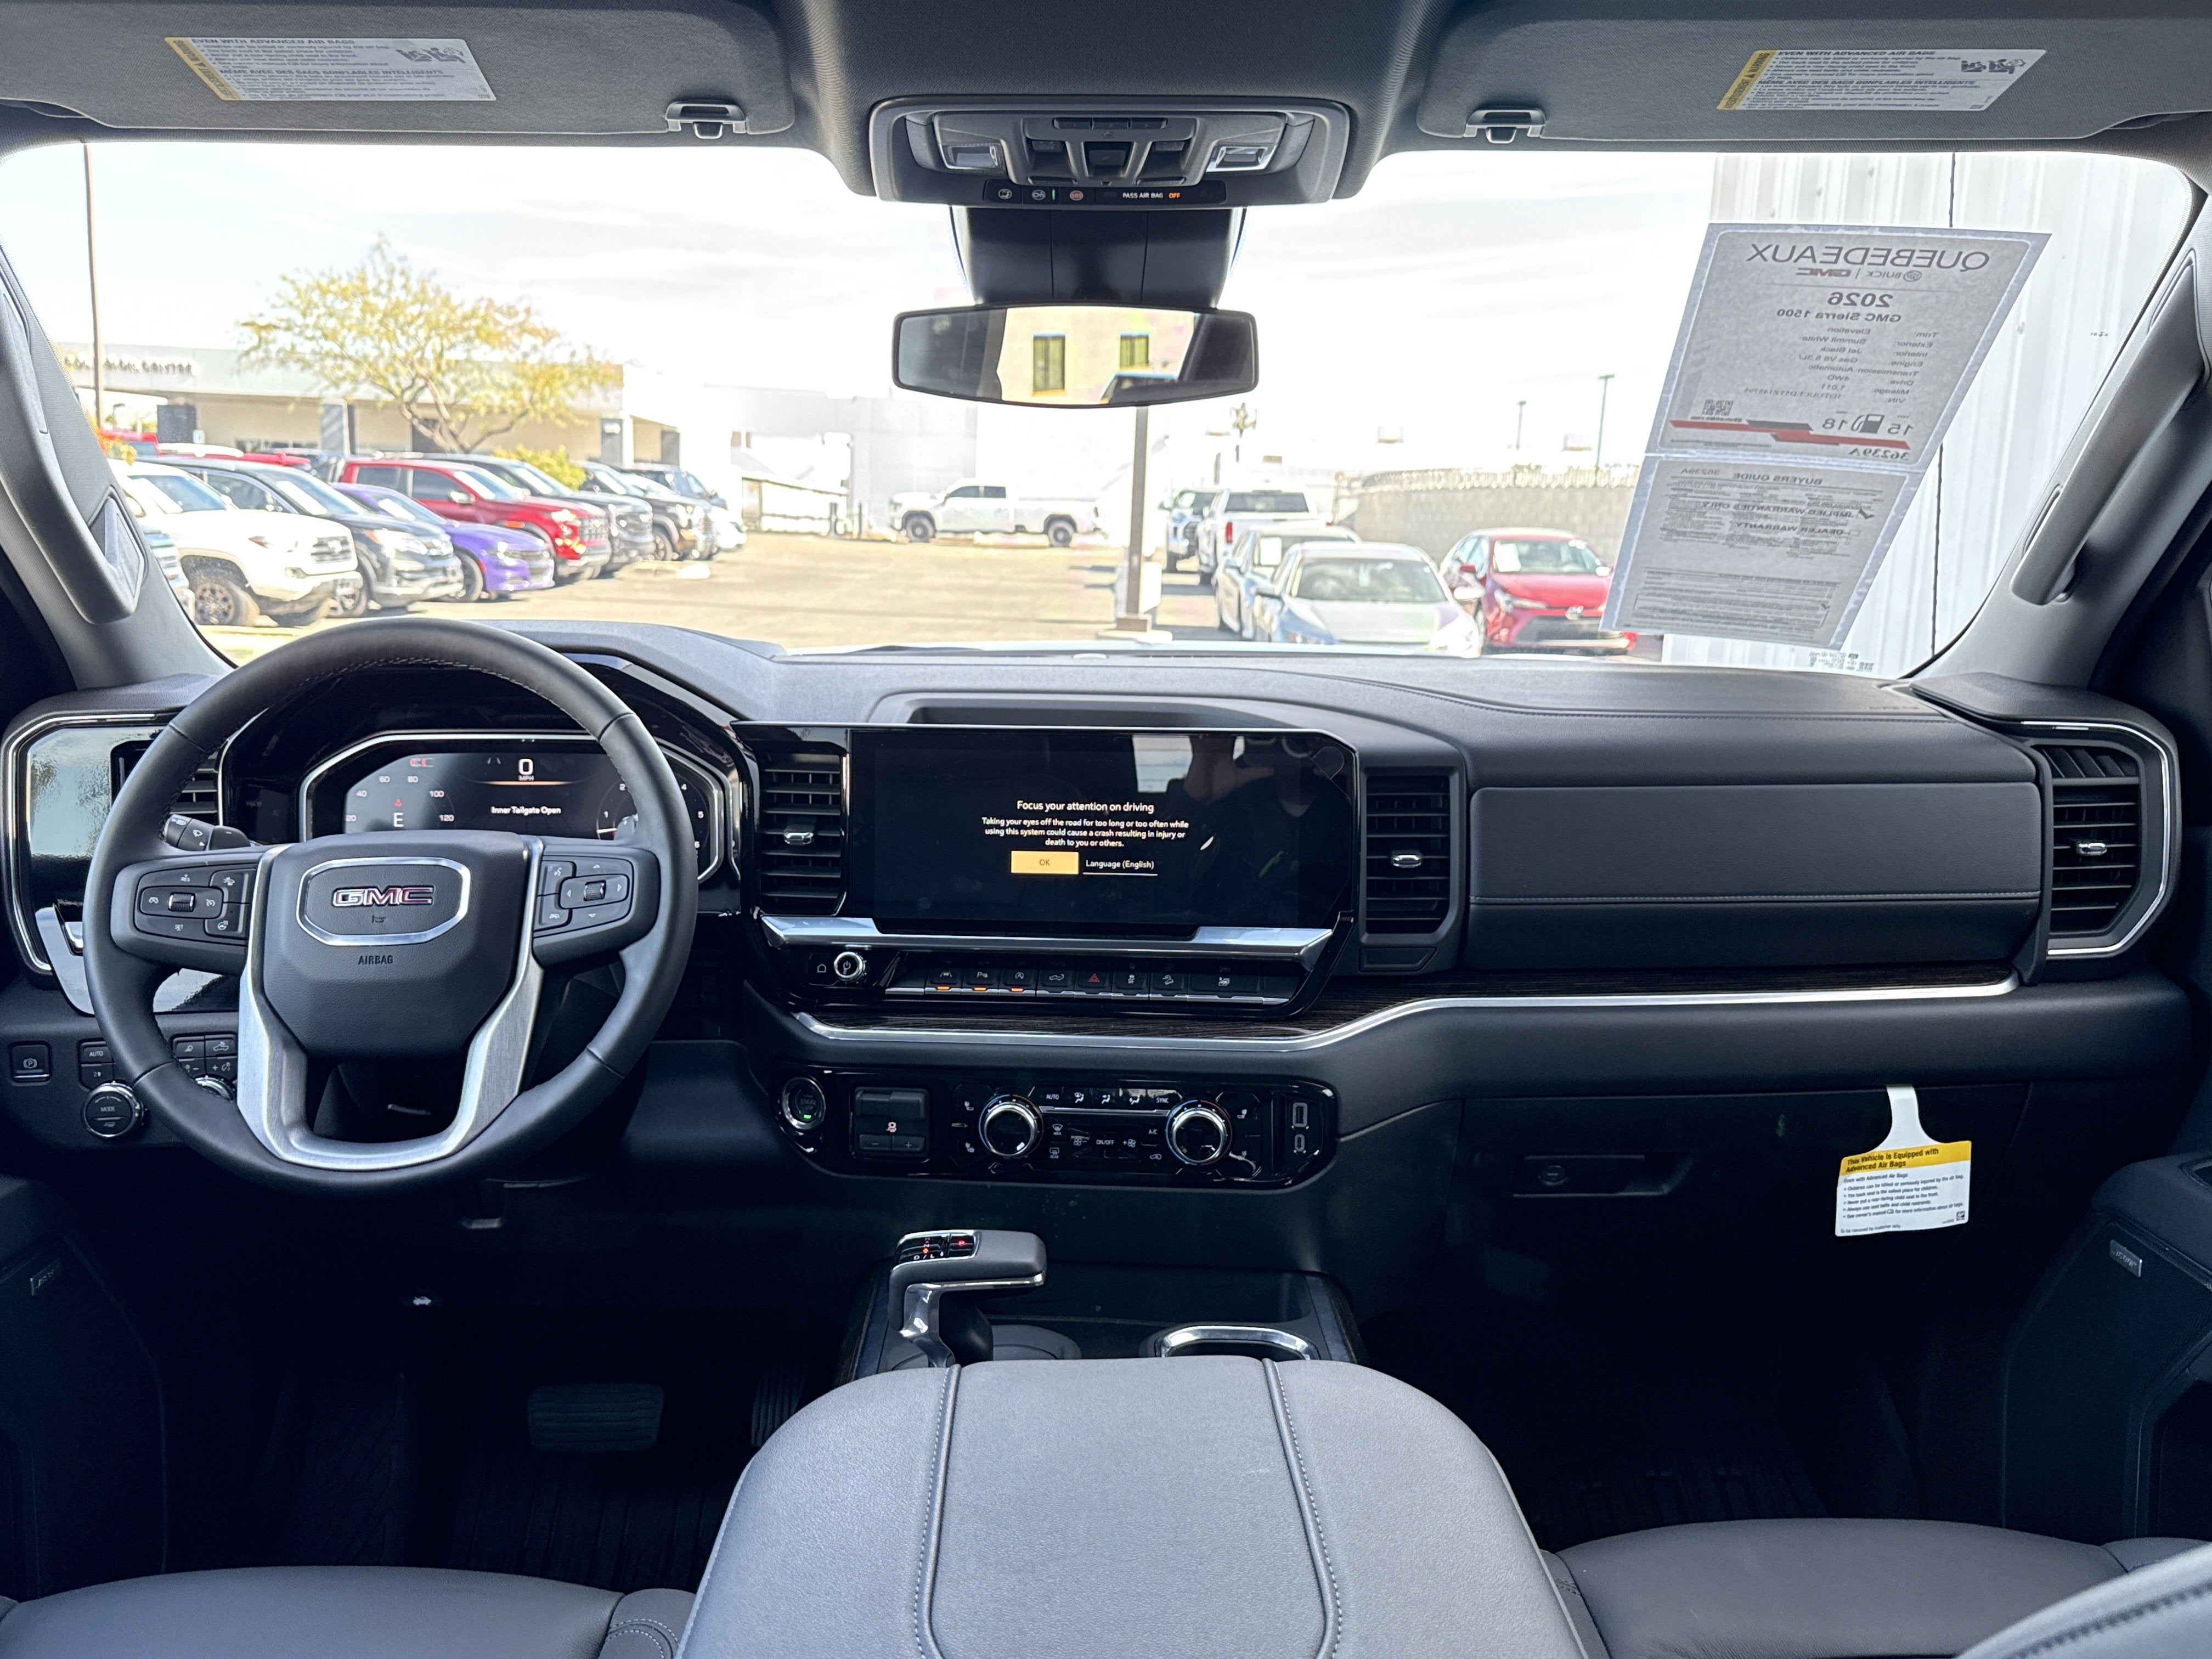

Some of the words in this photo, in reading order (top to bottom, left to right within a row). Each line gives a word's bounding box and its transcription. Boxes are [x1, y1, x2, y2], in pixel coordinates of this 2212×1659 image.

[511, 806, 540, 816] Tailgate
[540, 806, 562, 816] Open
[1017, 800, 1043, 810] Focus
[1045, 803, 1065, 812] your
[1066, 802, 1108, 811] attention
[1122, 802, 1154, 814] driving
[393, 812, 404, 827] E
[981, 816, 1005, 827] Taking
[1005, 819, 1023, 827] your
[1023, 819, 1040, 827] eyes
[1040, 818, 1052, 826] off
[1052, 818, 1065, 826] the
[1065, 818, 1082, 826] road
[1108, 819, 1125, 829] long
[1169, 820, 1189, 828] while
[985, 827, 1005, 837] using
[1020, 829, 1046, 837] system
[1115, 830, 1147, 839] resulting
[1155, 830, 1176, 840] injury
[1099, 839, 1125, 847] others.
[1085, 860, 1121, 869] Language
[1122, 860, 1154, 870] (English)
[332, 885, 435, 907] GMC
[358, 955, 394, 966] AIRBAG
[1861, 1154, 1884, 1163] Vehicle
[1893, 1149, 1923, 1160] Equipped
[1846, 1163, 1876, 1173] Advanced
